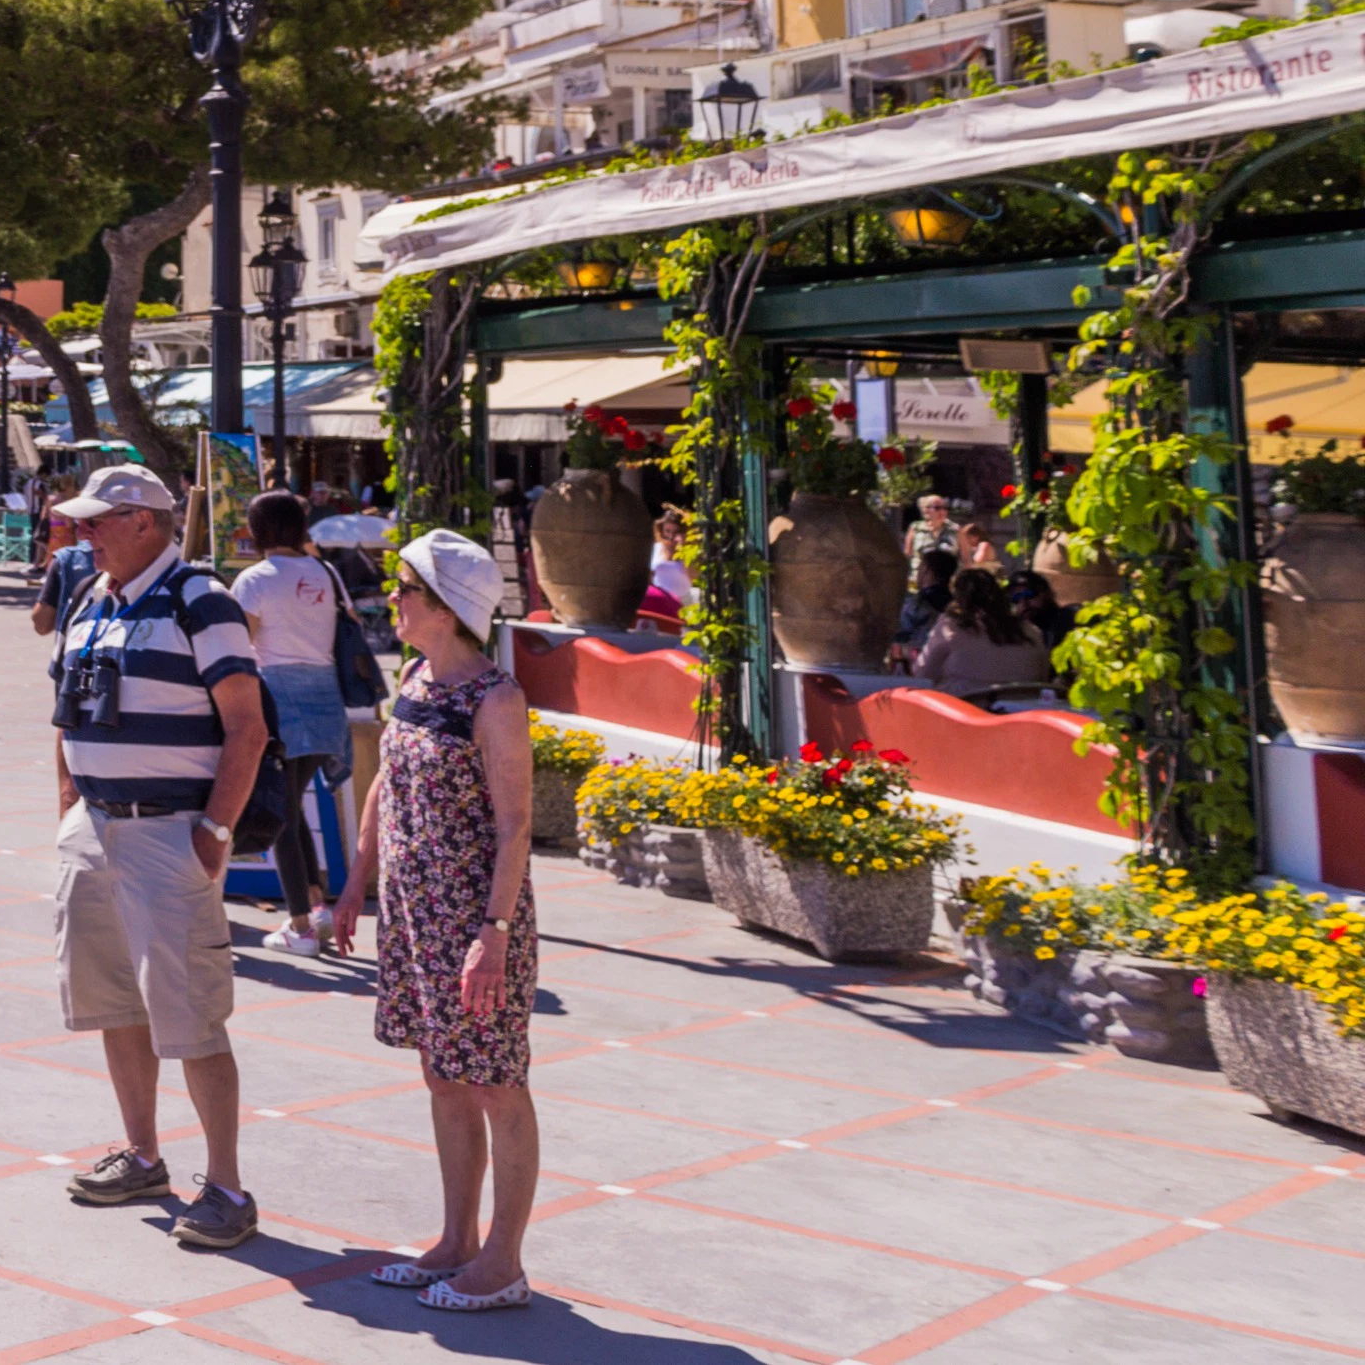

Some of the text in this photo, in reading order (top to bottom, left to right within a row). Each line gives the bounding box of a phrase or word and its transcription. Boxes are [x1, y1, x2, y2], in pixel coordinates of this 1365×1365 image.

[614, 66, 659, 75] LOUNGE
[1187, 47, 1333, 101] Ristorante
[729, 160, 800, 190] Gelateria
